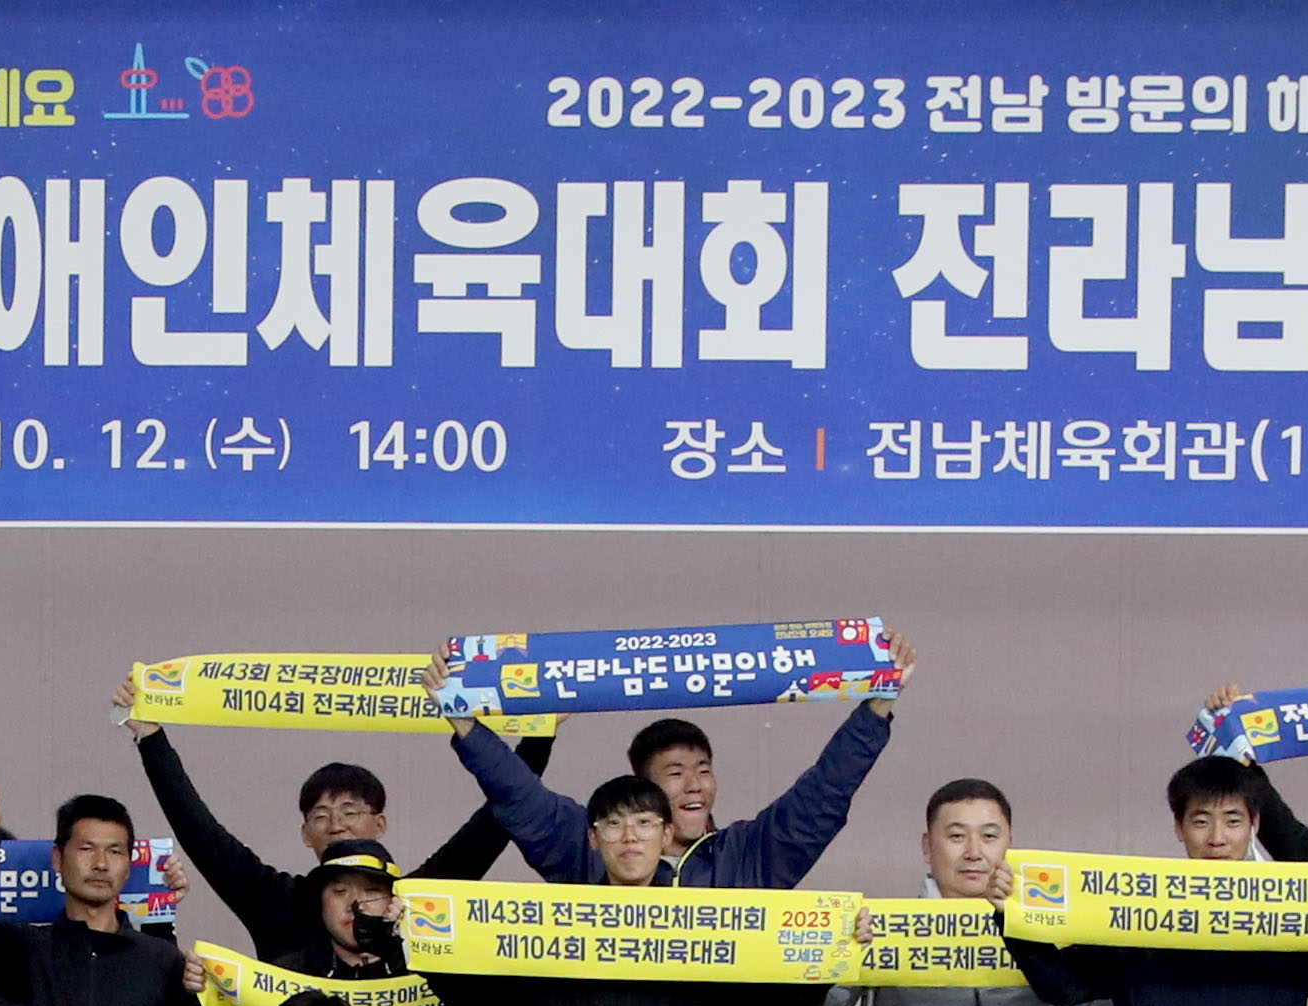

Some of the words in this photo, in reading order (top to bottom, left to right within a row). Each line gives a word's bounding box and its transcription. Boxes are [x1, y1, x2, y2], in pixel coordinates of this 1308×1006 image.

[548, 77, 905, 128] 2022-2023
[926, 75, 1049, 132] 전남
[1067, 75, 1247, 132] 방문의
[350, 420, 506, 471] 14:00
[663, 419, 786, 479] 장소
[616, 633, 716, 650] 2022-2023
[198, 662, 270, 682] 제43회
[544, 656, 668, 698] 전라남도
[676, 652, 766, 696] 방문의
[772, 646, 817, 678] 해
[145, 694, 183, 706] 전라남도
[223, 689, 304, 714] 제104회
[1081, 871, 1157, 898] 제43회
[467, 899, 543, 925] 제43회
[552, 903, 765, 931] 전국장애인체육대회
[782, 911, 830, 927] 2023
[1024, 913, 1066, 926] 전라남도
[1110, 907, 1198, 933] 제104회
[411, 941, 453, 955] 전라남도
[496, 934, 585, 961] 제104회
[596, 938, 735, 964] 전국체육대회
[778, 930, 832, 945] 전남으로
[783, 948, 823, 962] 오세요
